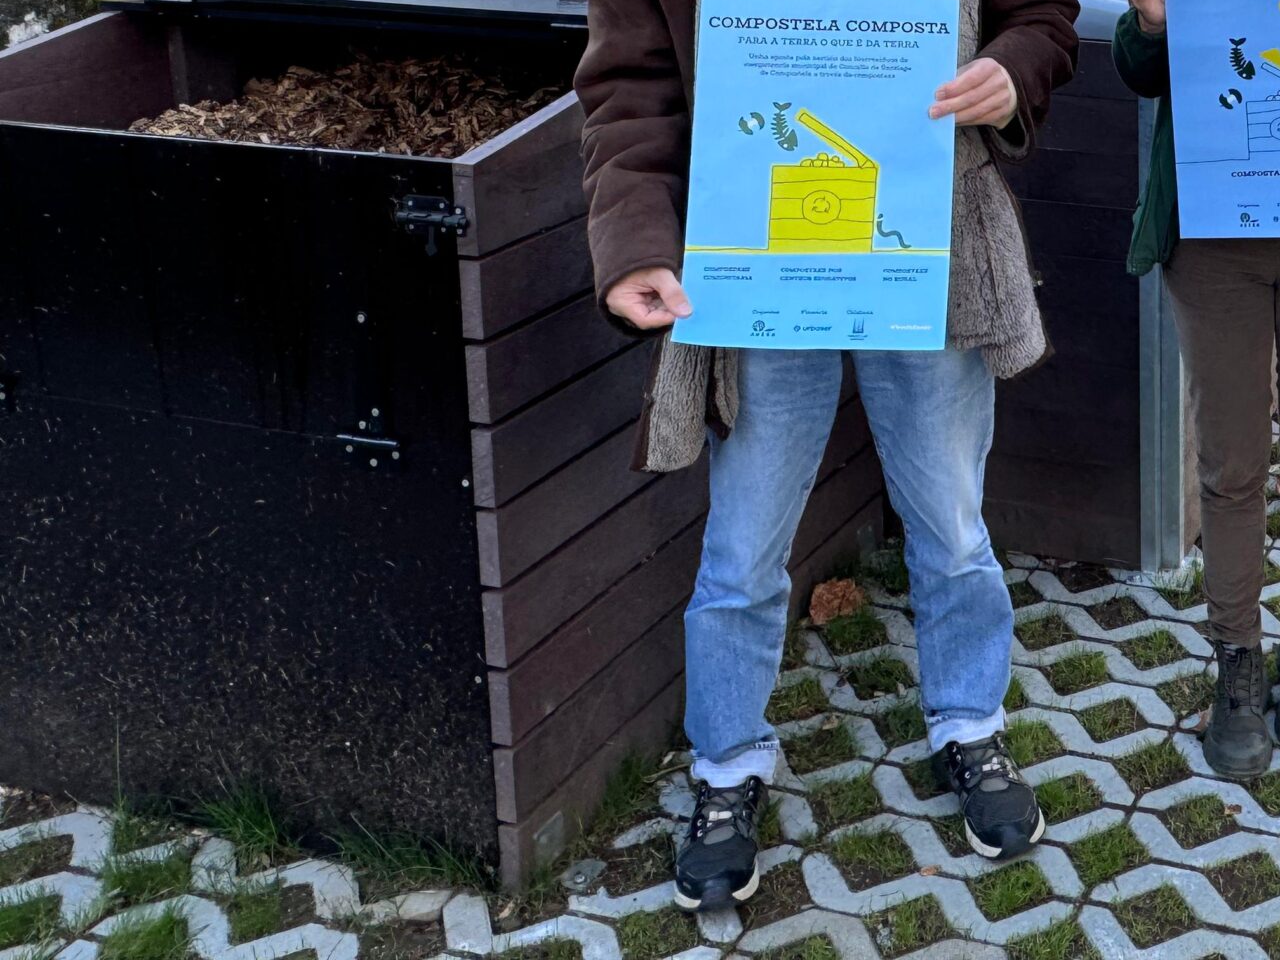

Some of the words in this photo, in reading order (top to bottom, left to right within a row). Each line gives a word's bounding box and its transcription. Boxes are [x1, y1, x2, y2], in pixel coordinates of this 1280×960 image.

[709, 16, 841, 32] COMPOSTELA
[846, 20, 950, 35] COMPOSTA
[738, 36, 767, 45] PARA
[771, 37, 779, 45] A
[781, 37, 817, 46] TERRA
[820, 38, 828, 47] O
[830, 39, 852, 48] QUE
[866, 40, 881, 49] DA
[883, 40, 919, 49] TERRA
